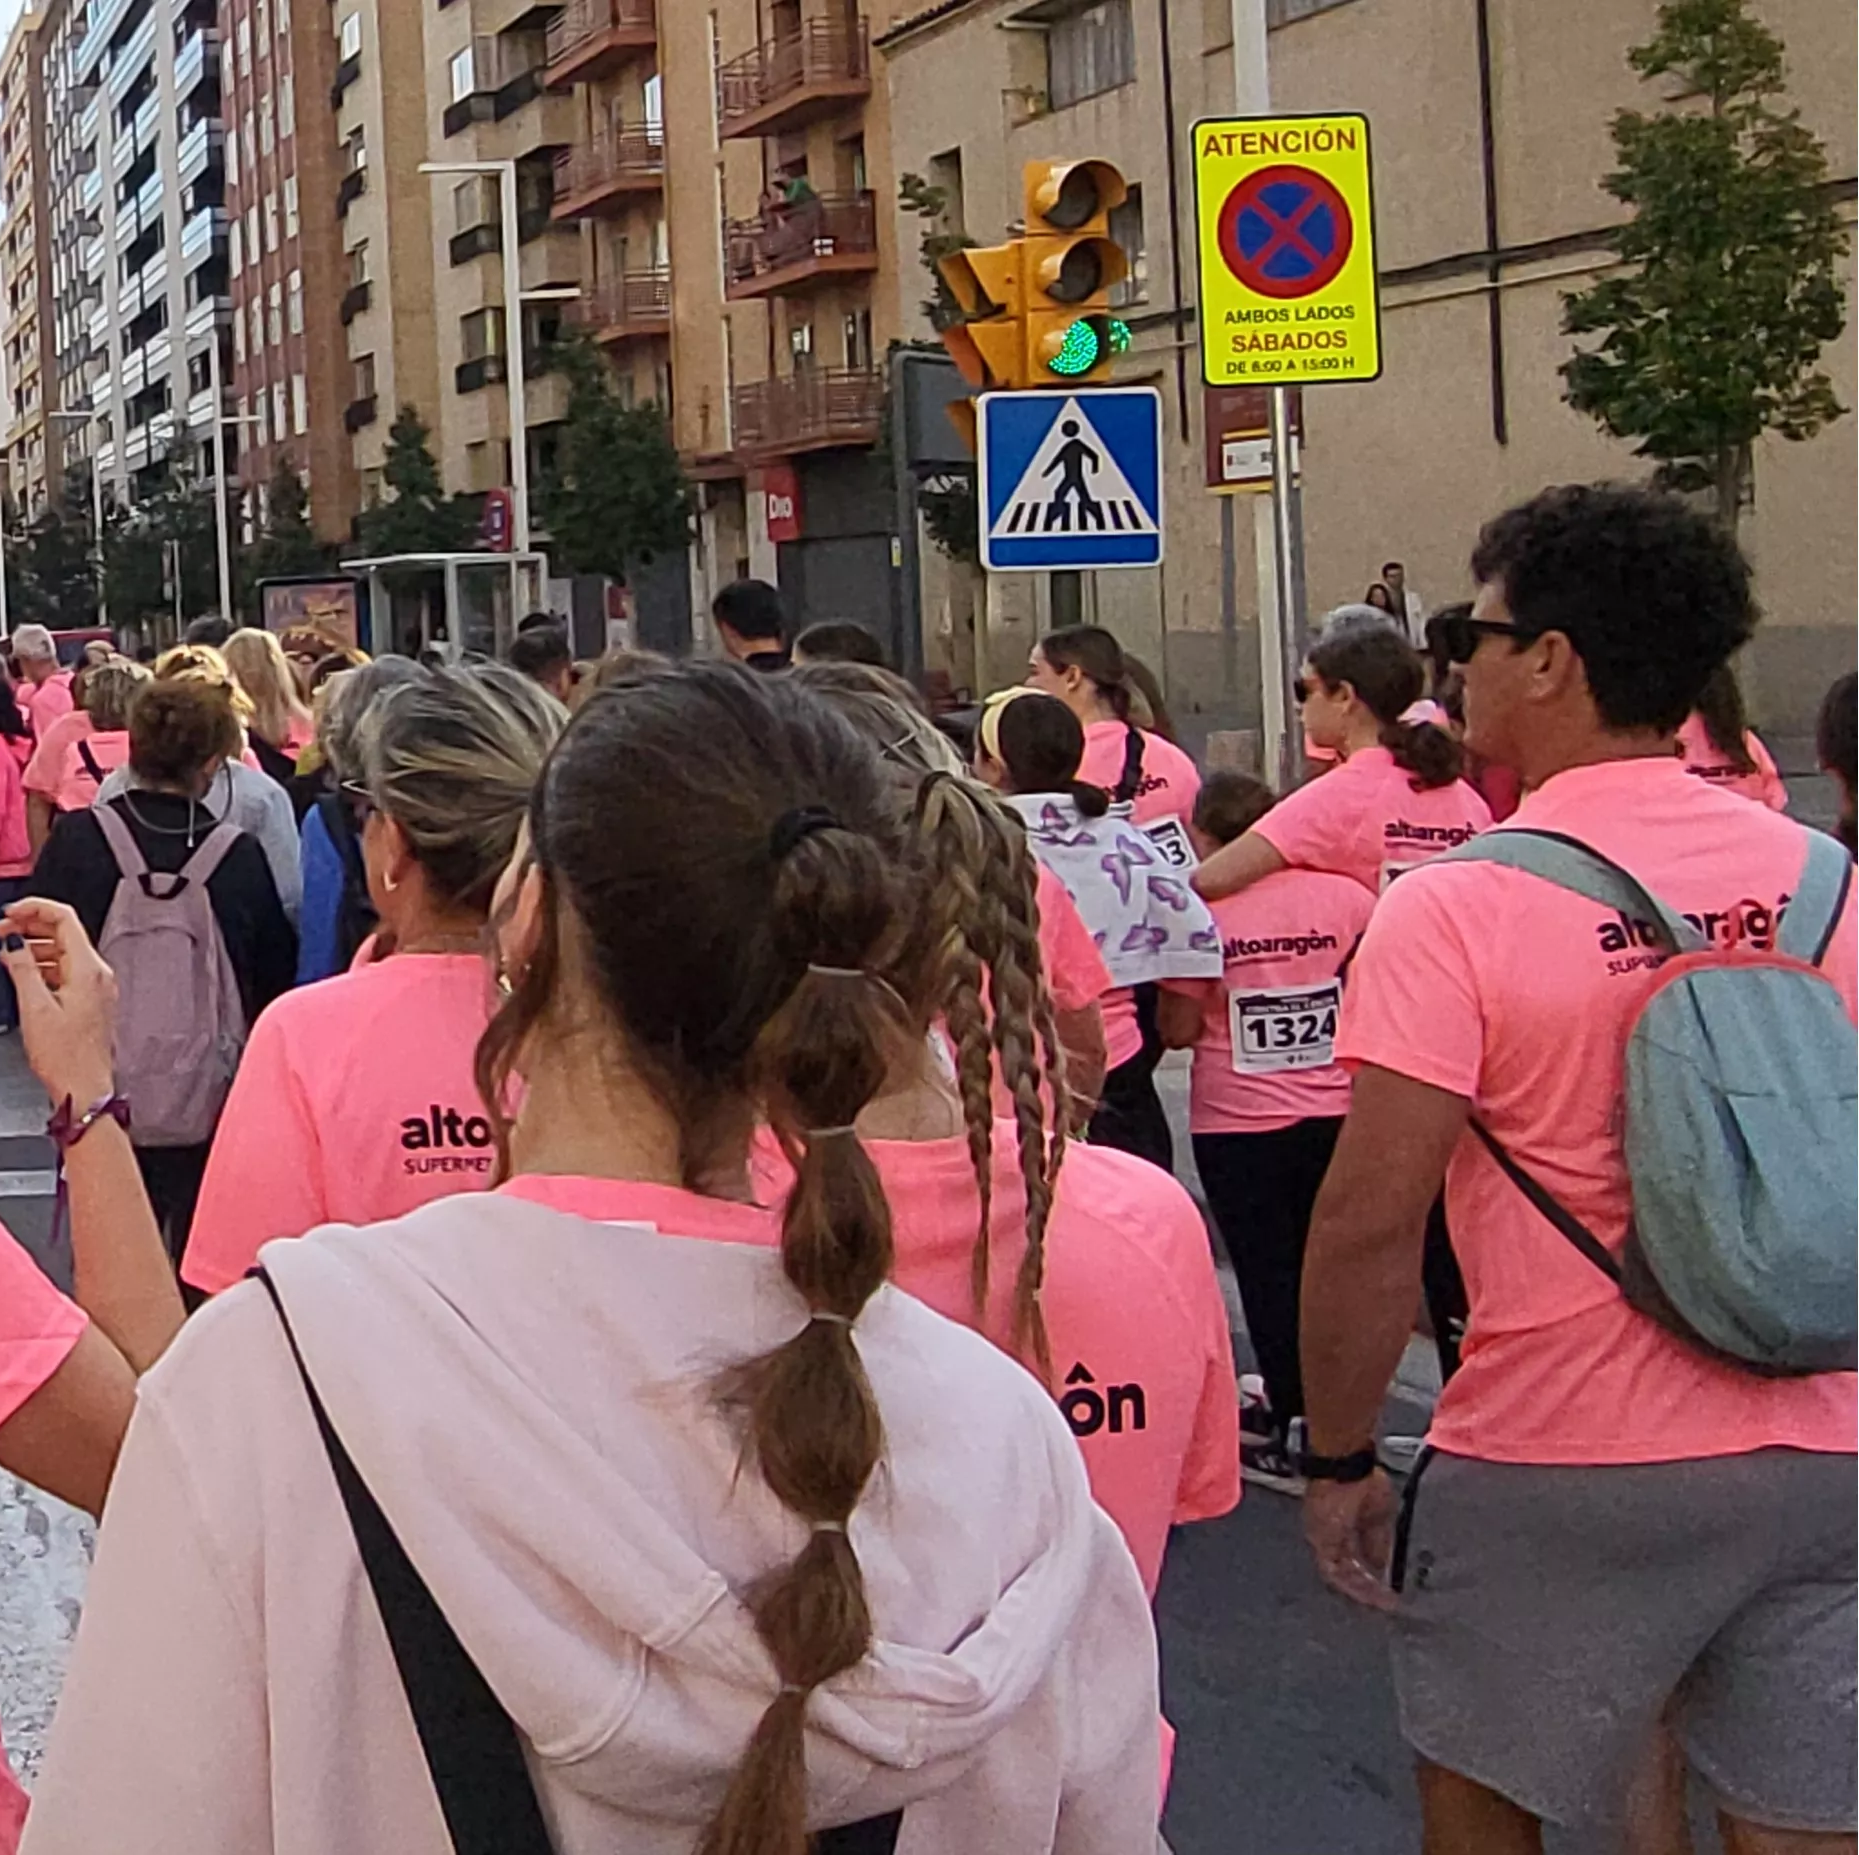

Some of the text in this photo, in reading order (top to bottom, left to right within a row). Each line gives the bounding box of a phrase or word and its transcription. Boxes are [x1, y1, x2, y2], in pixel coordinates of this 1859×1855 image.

[1203, 124, 1355, 157] ATENCIÓN
[1224, 304, 1355, 324] AMBOS LADOS
[1231, 329, 1347, 353] SÁBADOS
[1226, 361, 1246, 374] DE
[1286, 359, 1297, 370] A
[1302, 358, 1339, 371] 15:00
[1343, 357, 1355, 369] H
[1246, 1008, 1337, 1049] 1324
